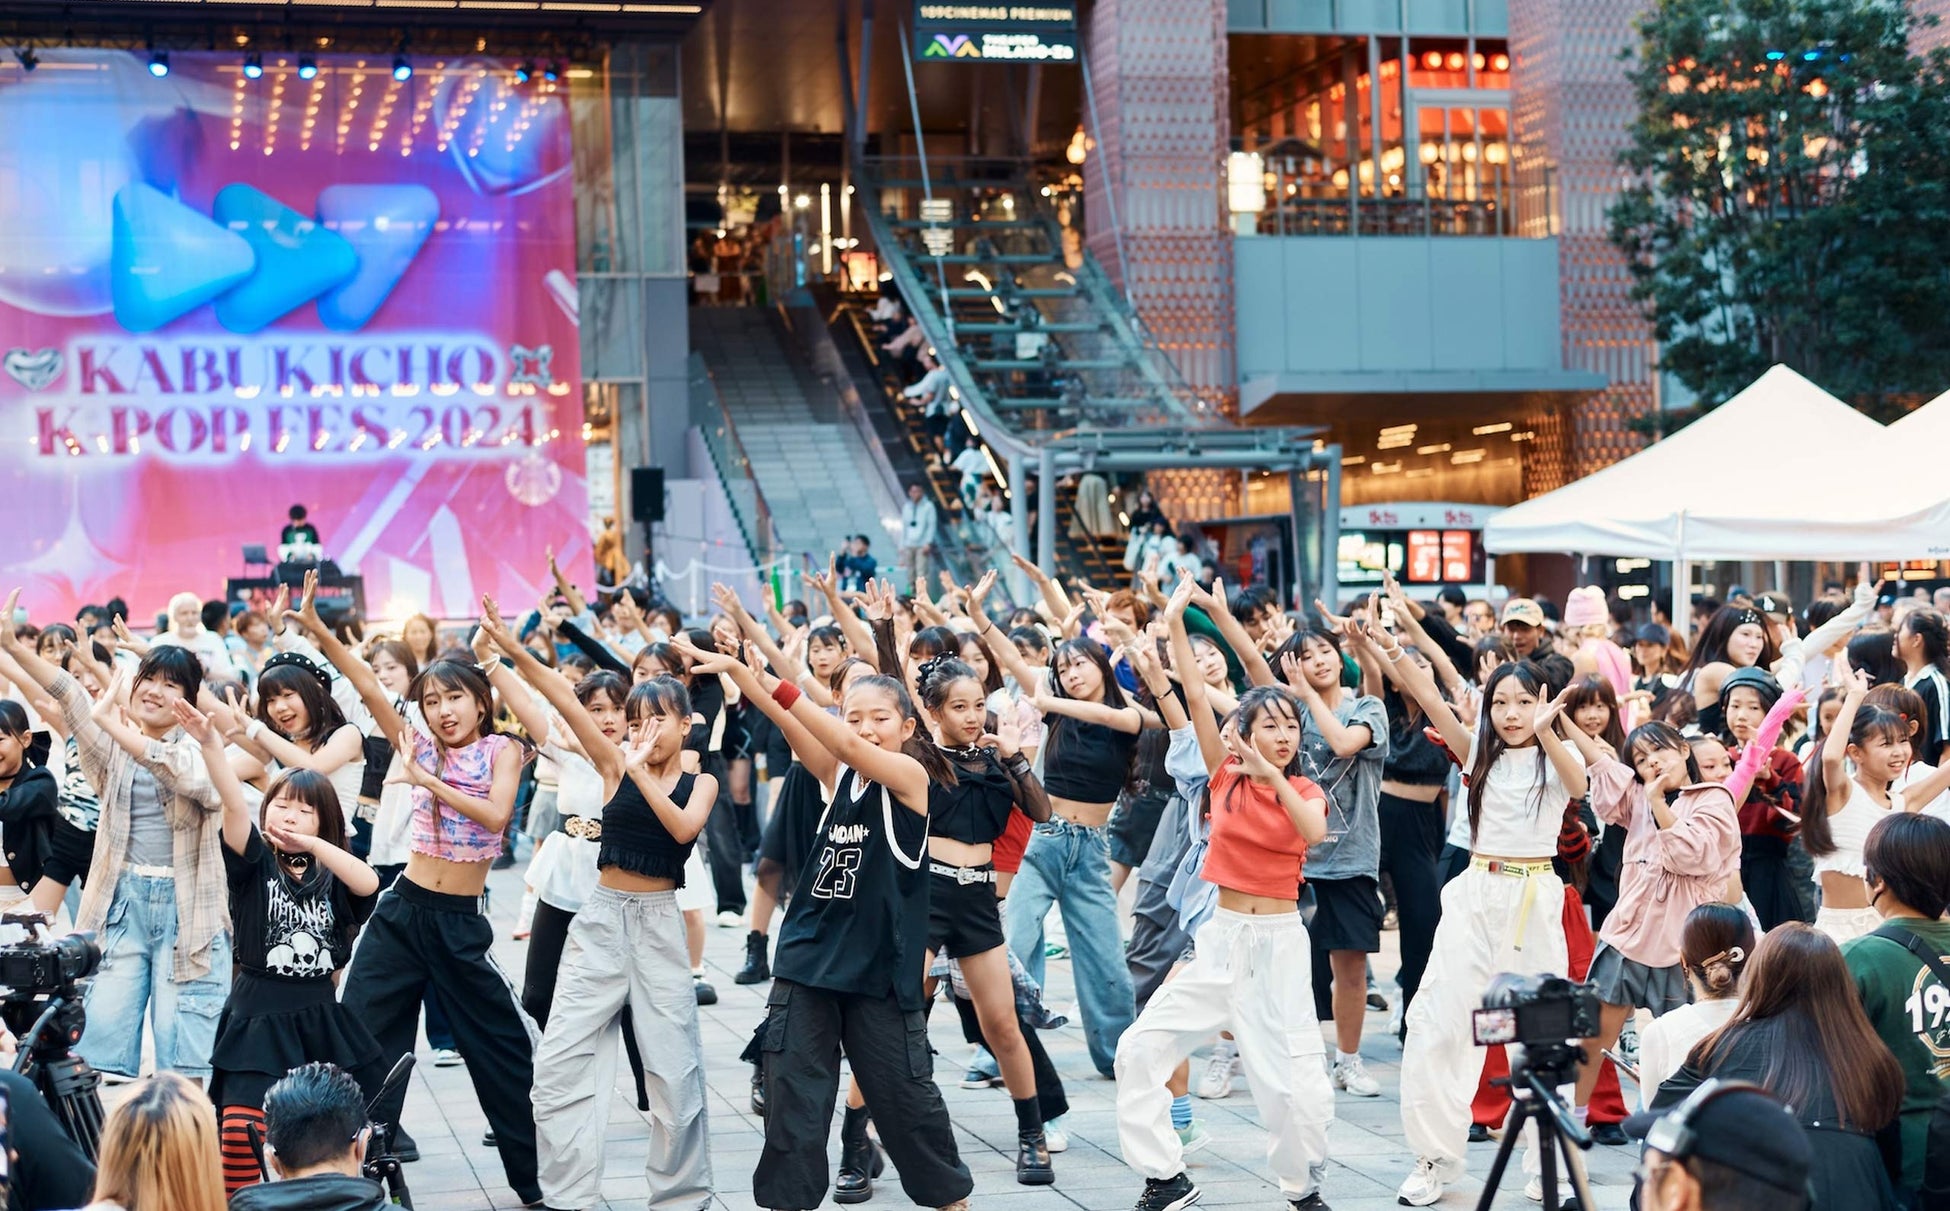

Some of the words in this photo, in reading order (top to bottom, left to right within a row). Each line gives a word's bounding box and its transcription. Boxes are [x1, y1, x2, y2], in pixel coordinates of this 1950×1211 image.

[78, 345, 497, 394] KABUKICHO
[36, 405, 251, 456] K-POP
[267, 403, 391, 452] FES
[407, 403, 538, 450] 2024
[811, 847, 862, 899] 23
